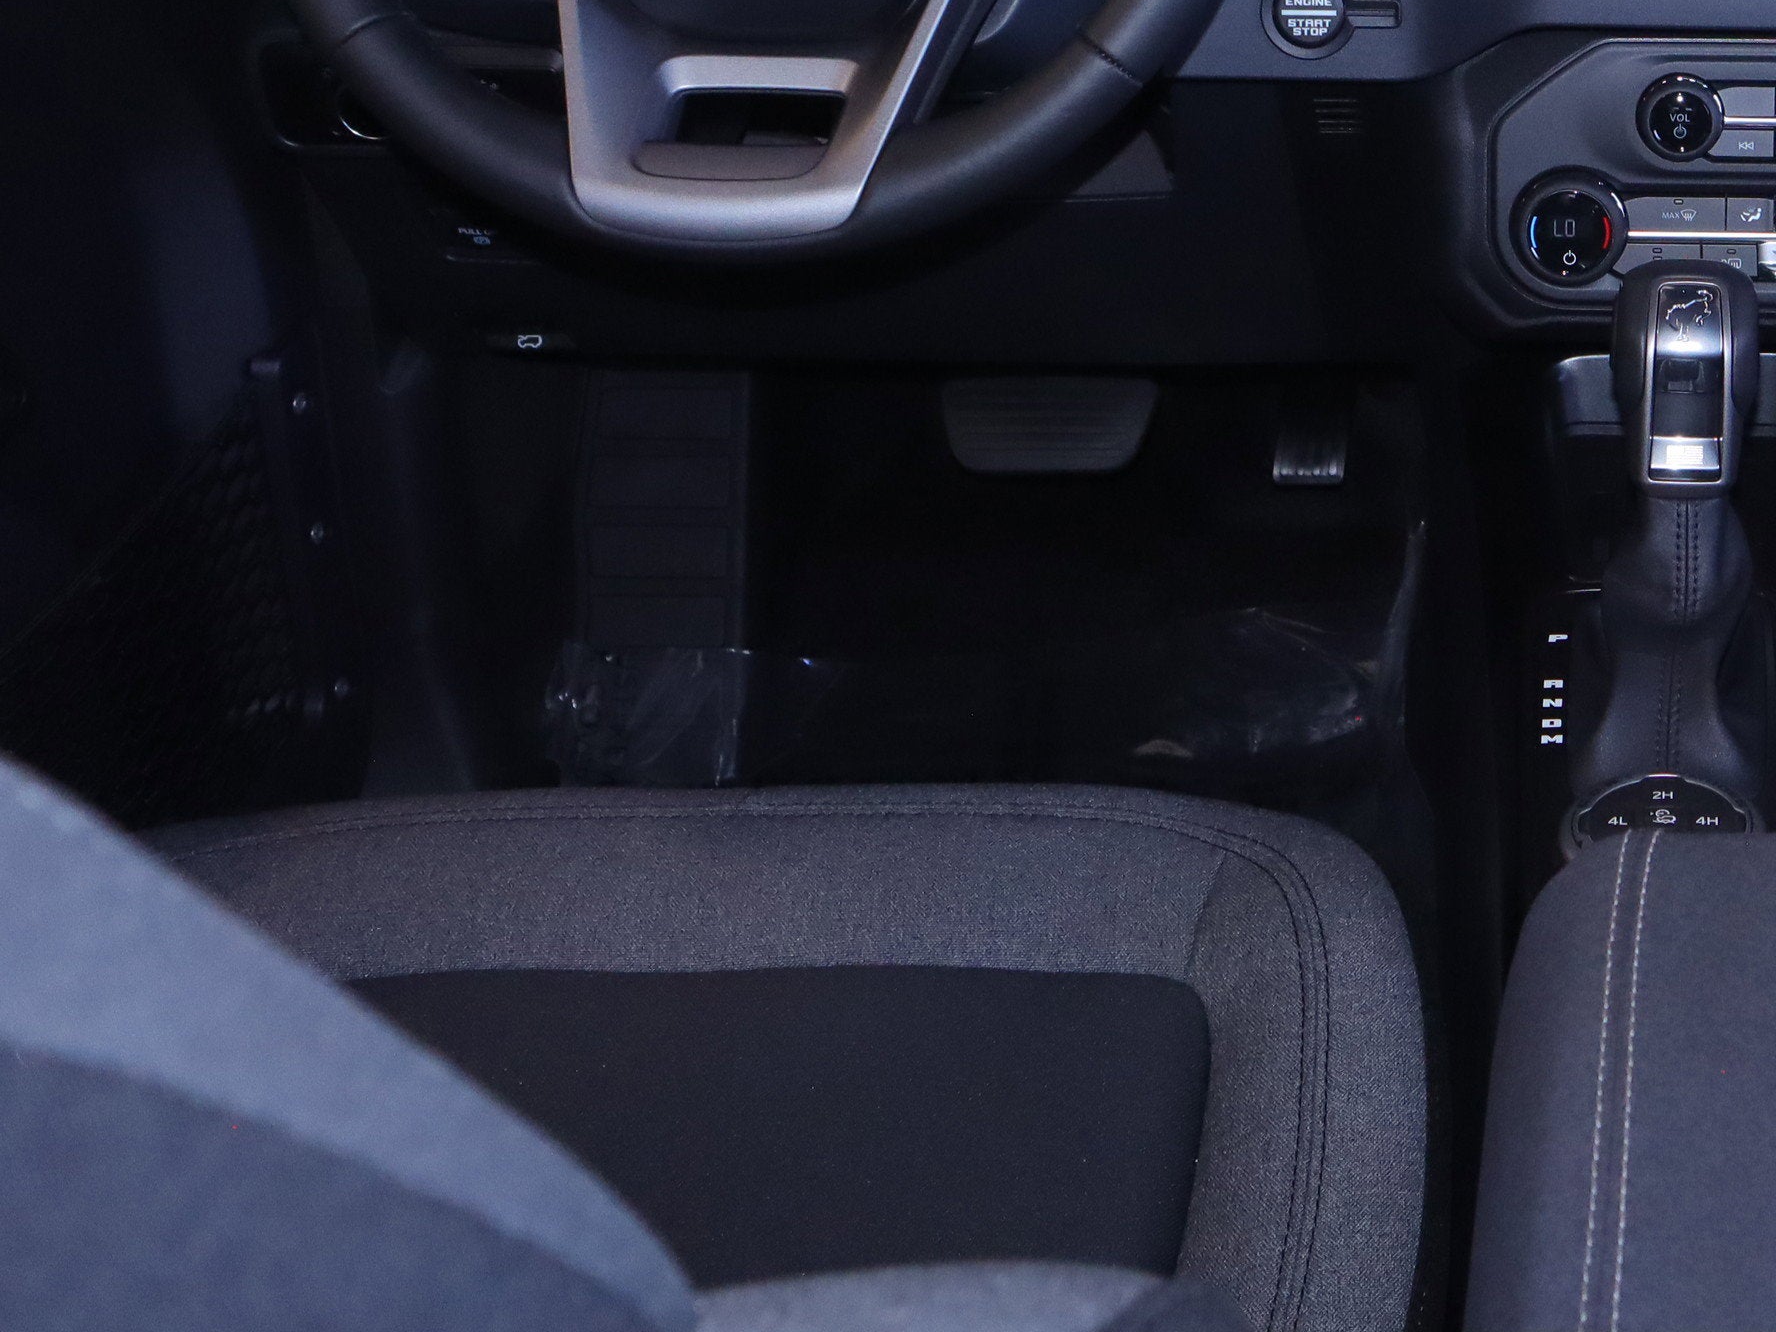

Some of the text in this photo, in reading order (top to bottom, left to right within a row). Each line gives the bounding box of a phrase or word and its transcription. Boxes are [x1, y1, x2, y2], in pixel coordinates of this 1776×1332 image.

[1287, 18, 1332, 27] START
[1293, 27, 1328, 36] STOP
[1669, 113, 1691, 123] VOL
[1553, 219, 1576, 238] LO
[1548, 634, 1568, 642] P
[1542, 698, 1563, 707] N
[1541, 719, 1562, 728] D
[1541, 735, 1563, 744] M
[1652, 791, 1674, 800] 2H
[1608, 817, 1628, 826] 4L
[1695, 817, 1719, 826] 4H
